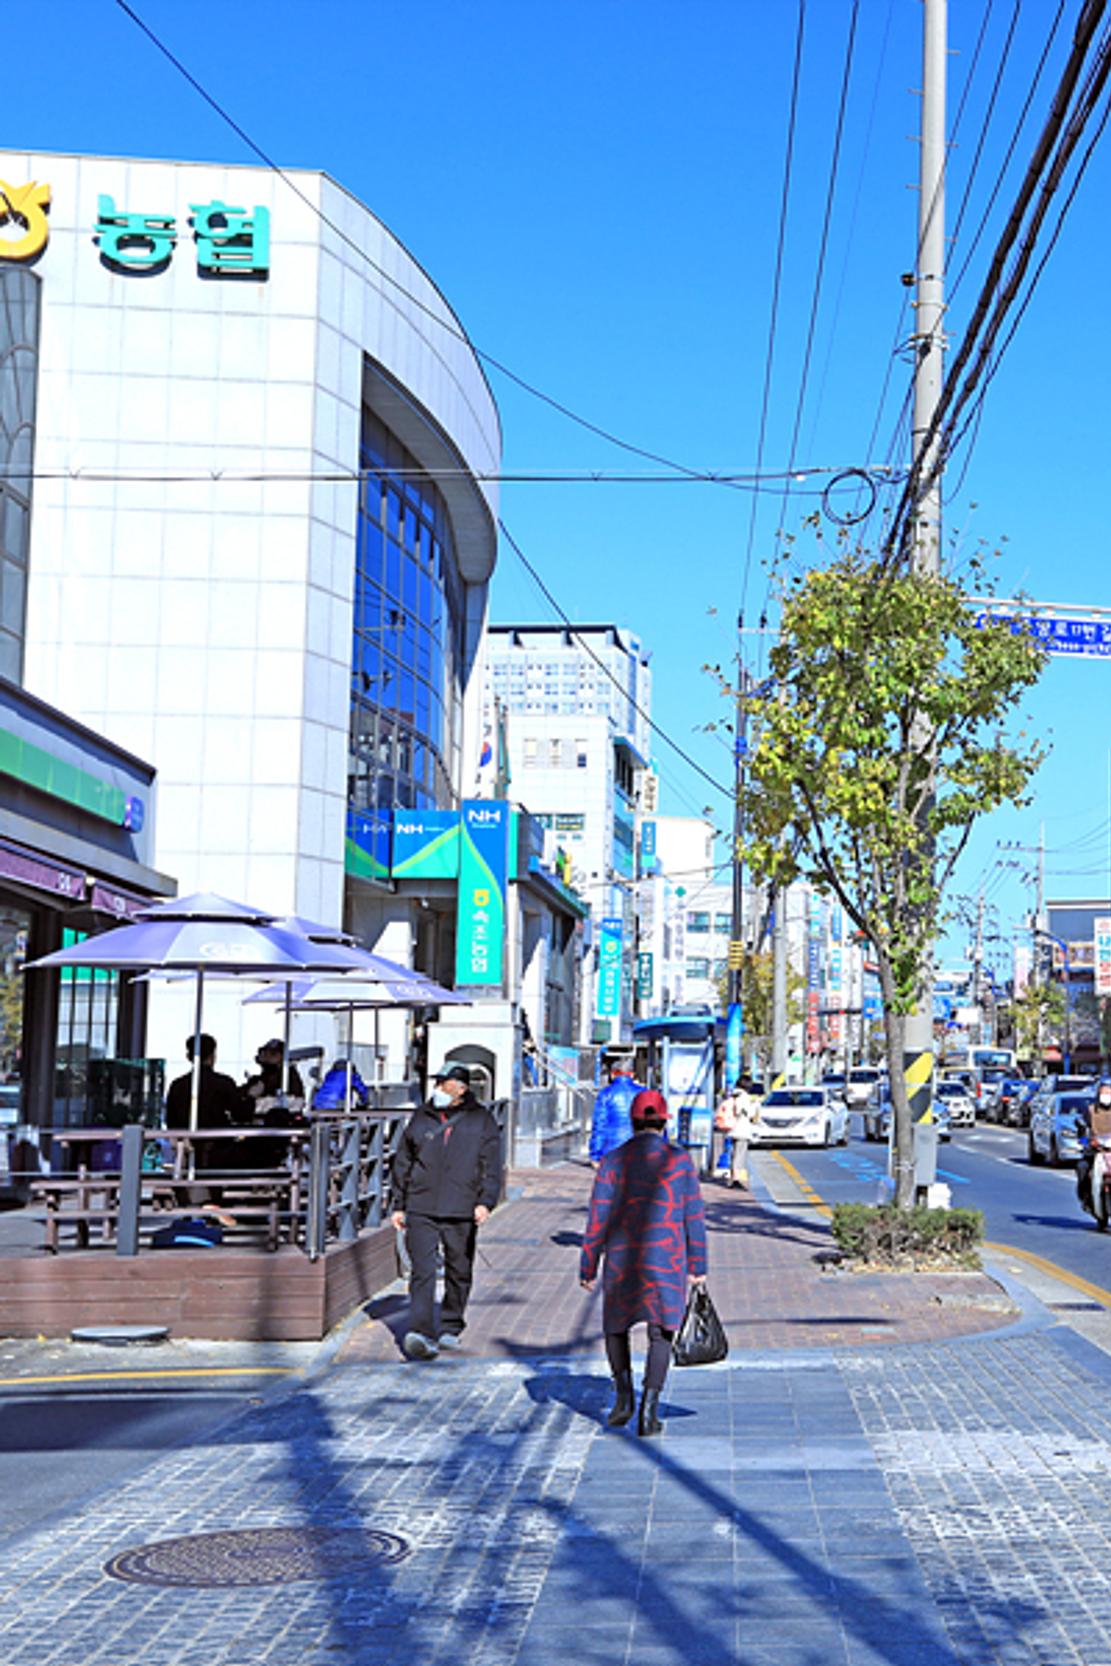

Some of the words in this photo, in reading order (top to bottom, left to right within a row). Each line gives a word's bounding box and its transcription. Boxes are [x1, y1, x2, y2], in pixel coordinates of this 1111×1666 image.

[92, 194, 271, 276] 농협
[468, 809, 501, 823] NH
[396, 823, 423, 835] NH
